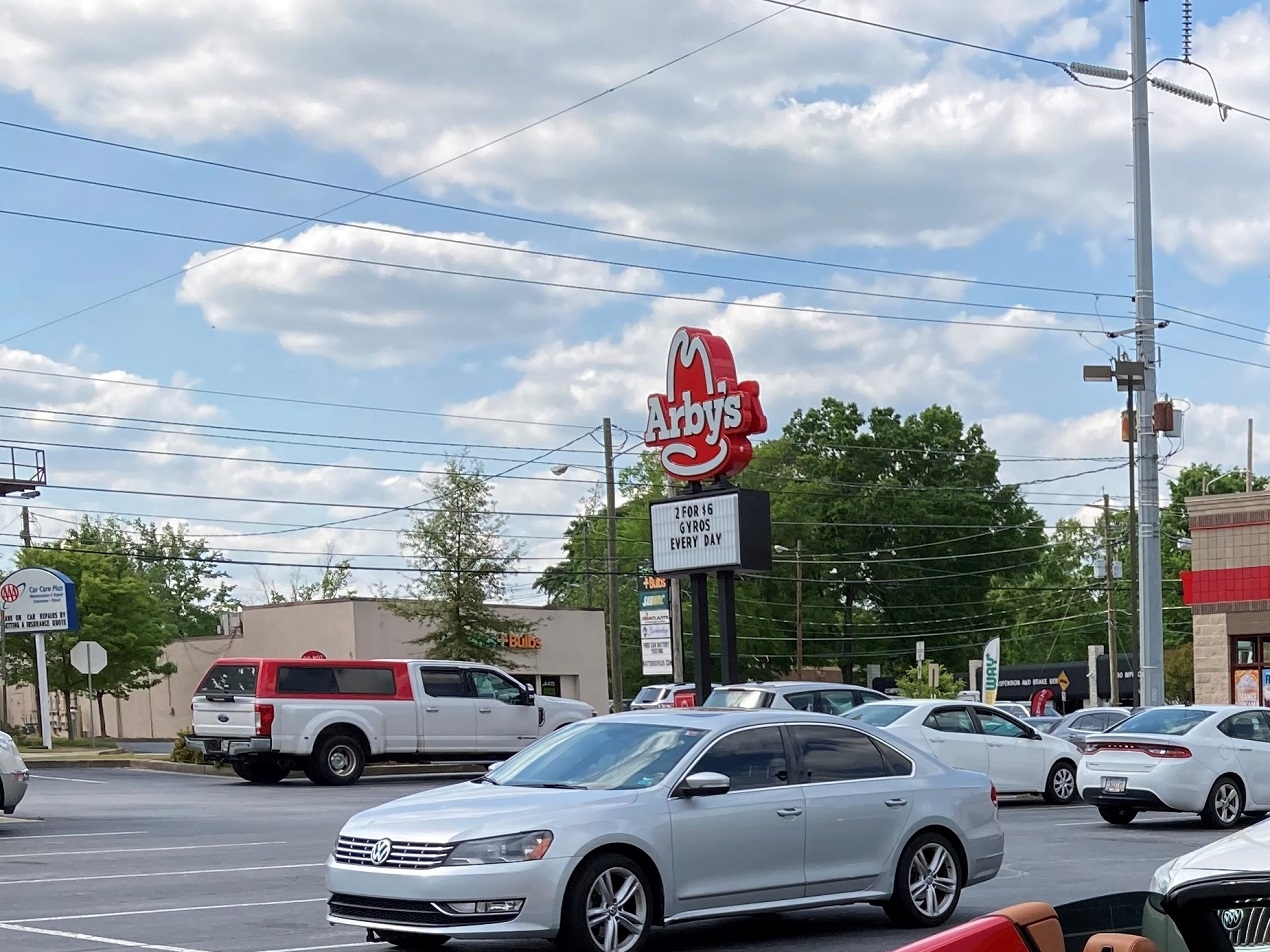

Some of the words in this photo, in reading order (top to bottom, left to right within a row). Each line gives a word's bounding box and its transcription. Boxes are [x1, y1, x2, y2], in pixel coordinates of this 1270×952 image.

[645, 381, 742, 445] Arby's
[675, 507, 680, 519] 2
[682, 505, 699, 518] FOR
[702, 503, 713, 516] $6
[680, 519, 711, 534] GYROS
[670, 536, 698, 550] EVERY
[704, 533, 722, 547] DAY
[1048, 677, 1059, 685] SER
